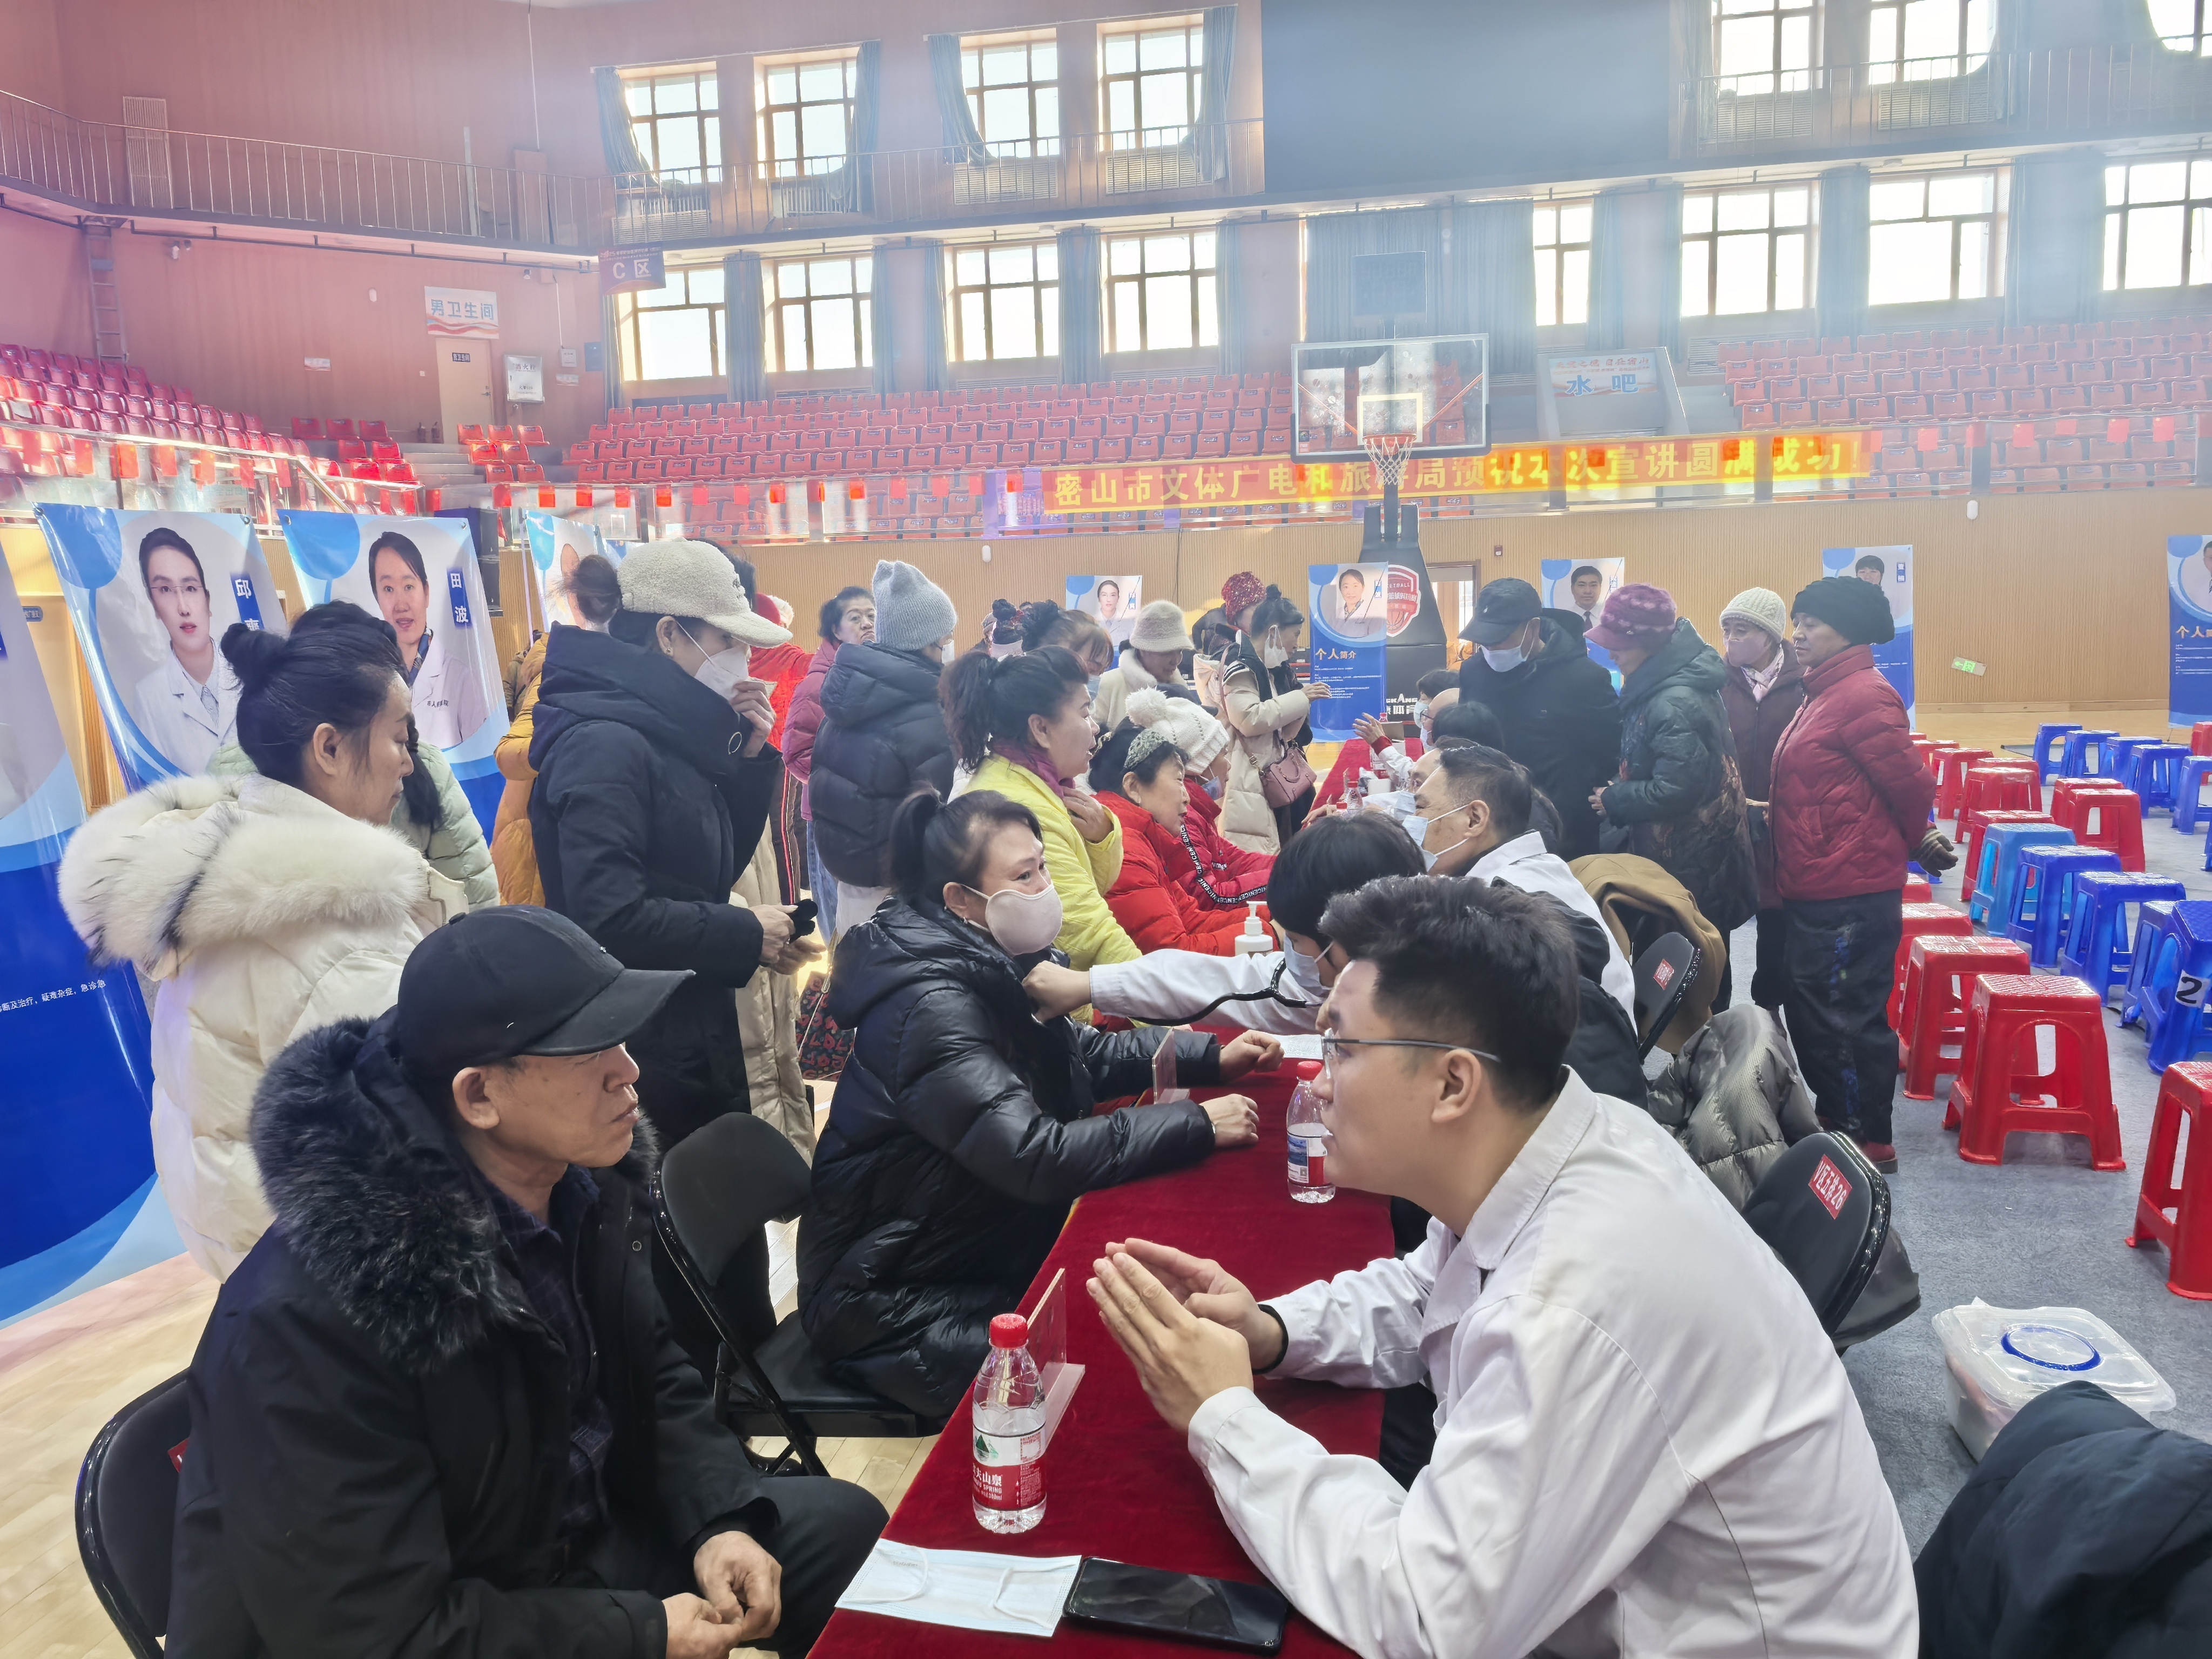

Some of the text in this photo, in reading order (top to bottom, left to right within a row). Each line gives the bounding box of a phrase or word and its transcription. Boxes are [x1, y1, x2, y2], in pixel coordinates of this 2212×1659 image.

[431, 299, 494, 320] 男卫生间
[1566, 373, 1639, 396] 水吧
[450, 572, 469, 623] 田波
[1315, 648, 1357, 660] 个人简介
[2176, 976, 2202, 1004] 2
[983, 1484, 1002, 1494] SPRING
